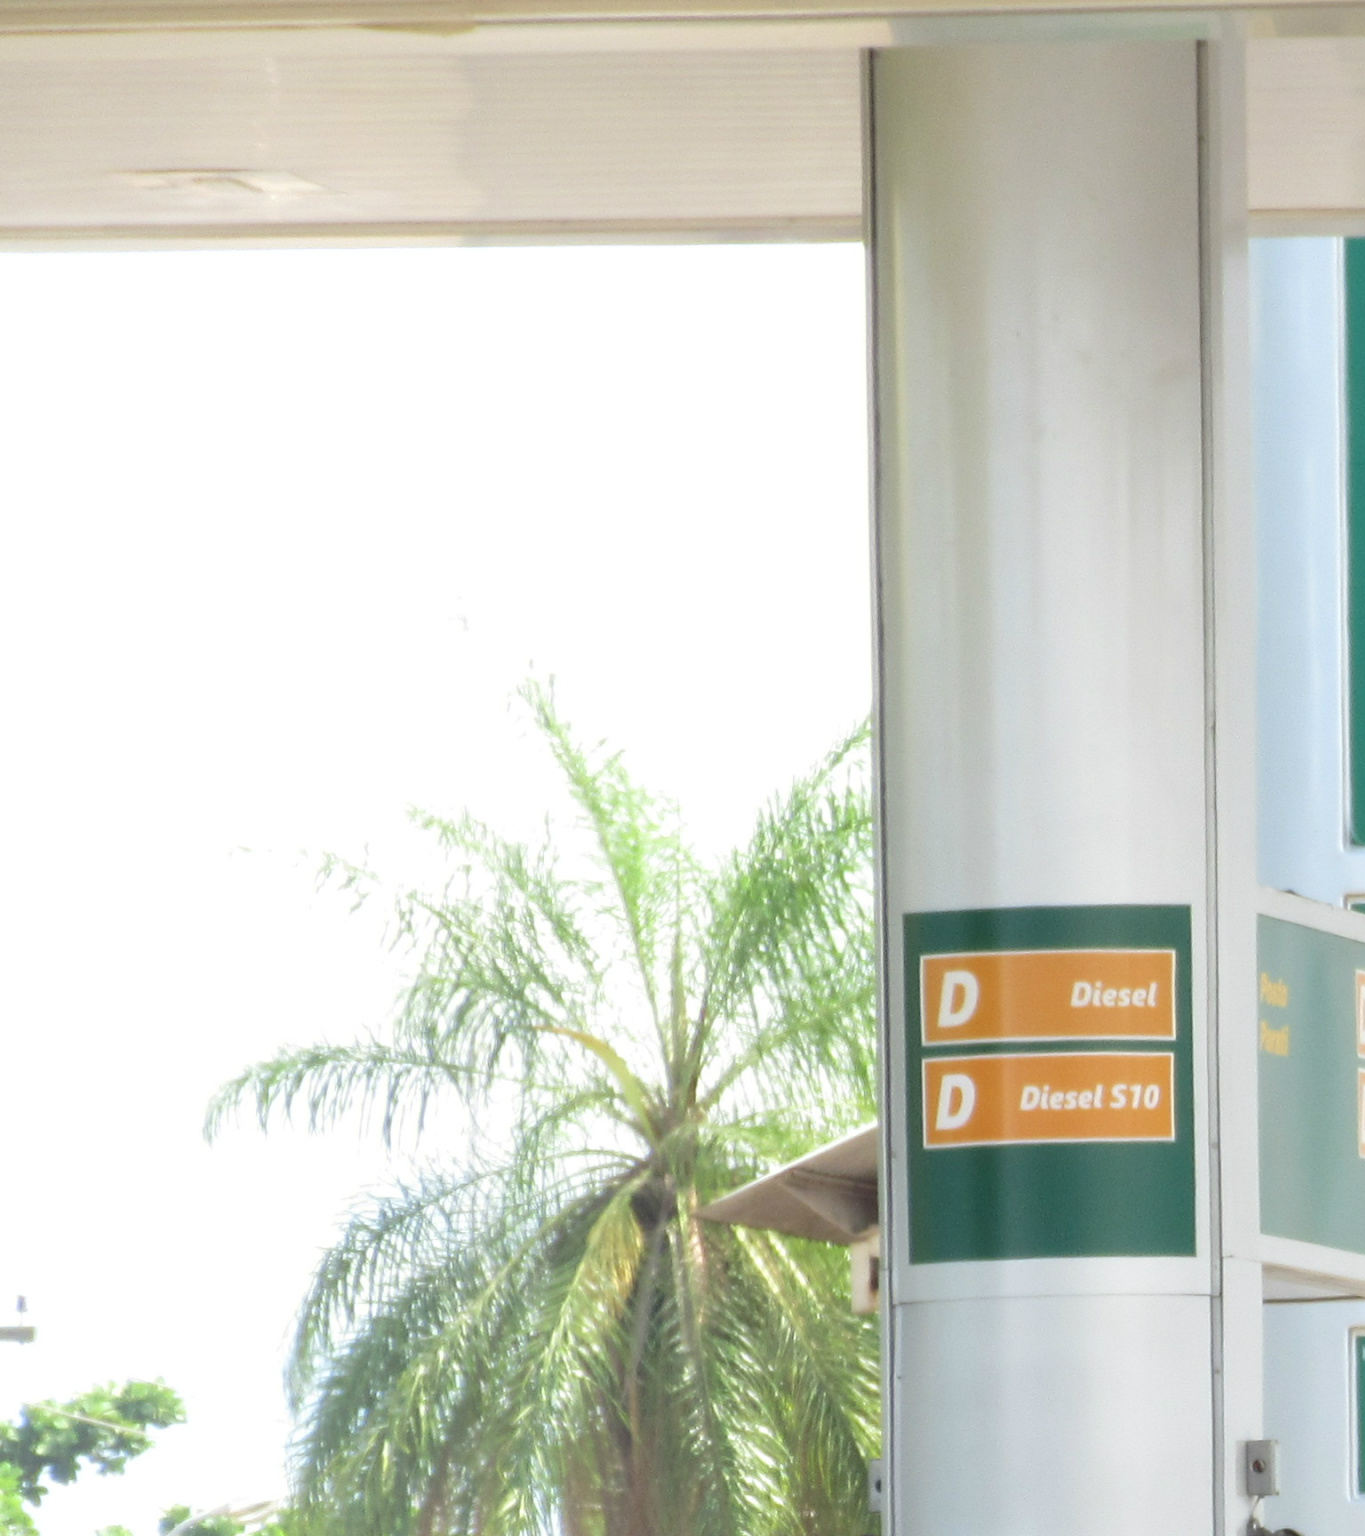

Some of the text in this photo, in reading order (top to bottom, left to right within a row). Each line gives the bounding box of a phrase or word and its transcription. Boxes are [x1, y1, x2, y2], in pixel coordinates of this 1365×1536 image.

[937, 970, 979, 1028] D
[1071, 981, 1158, 1008] Diesel
[936, 1073, 976, 1131] D
[1020, 1084, 1160, 1111] Diesel S10
